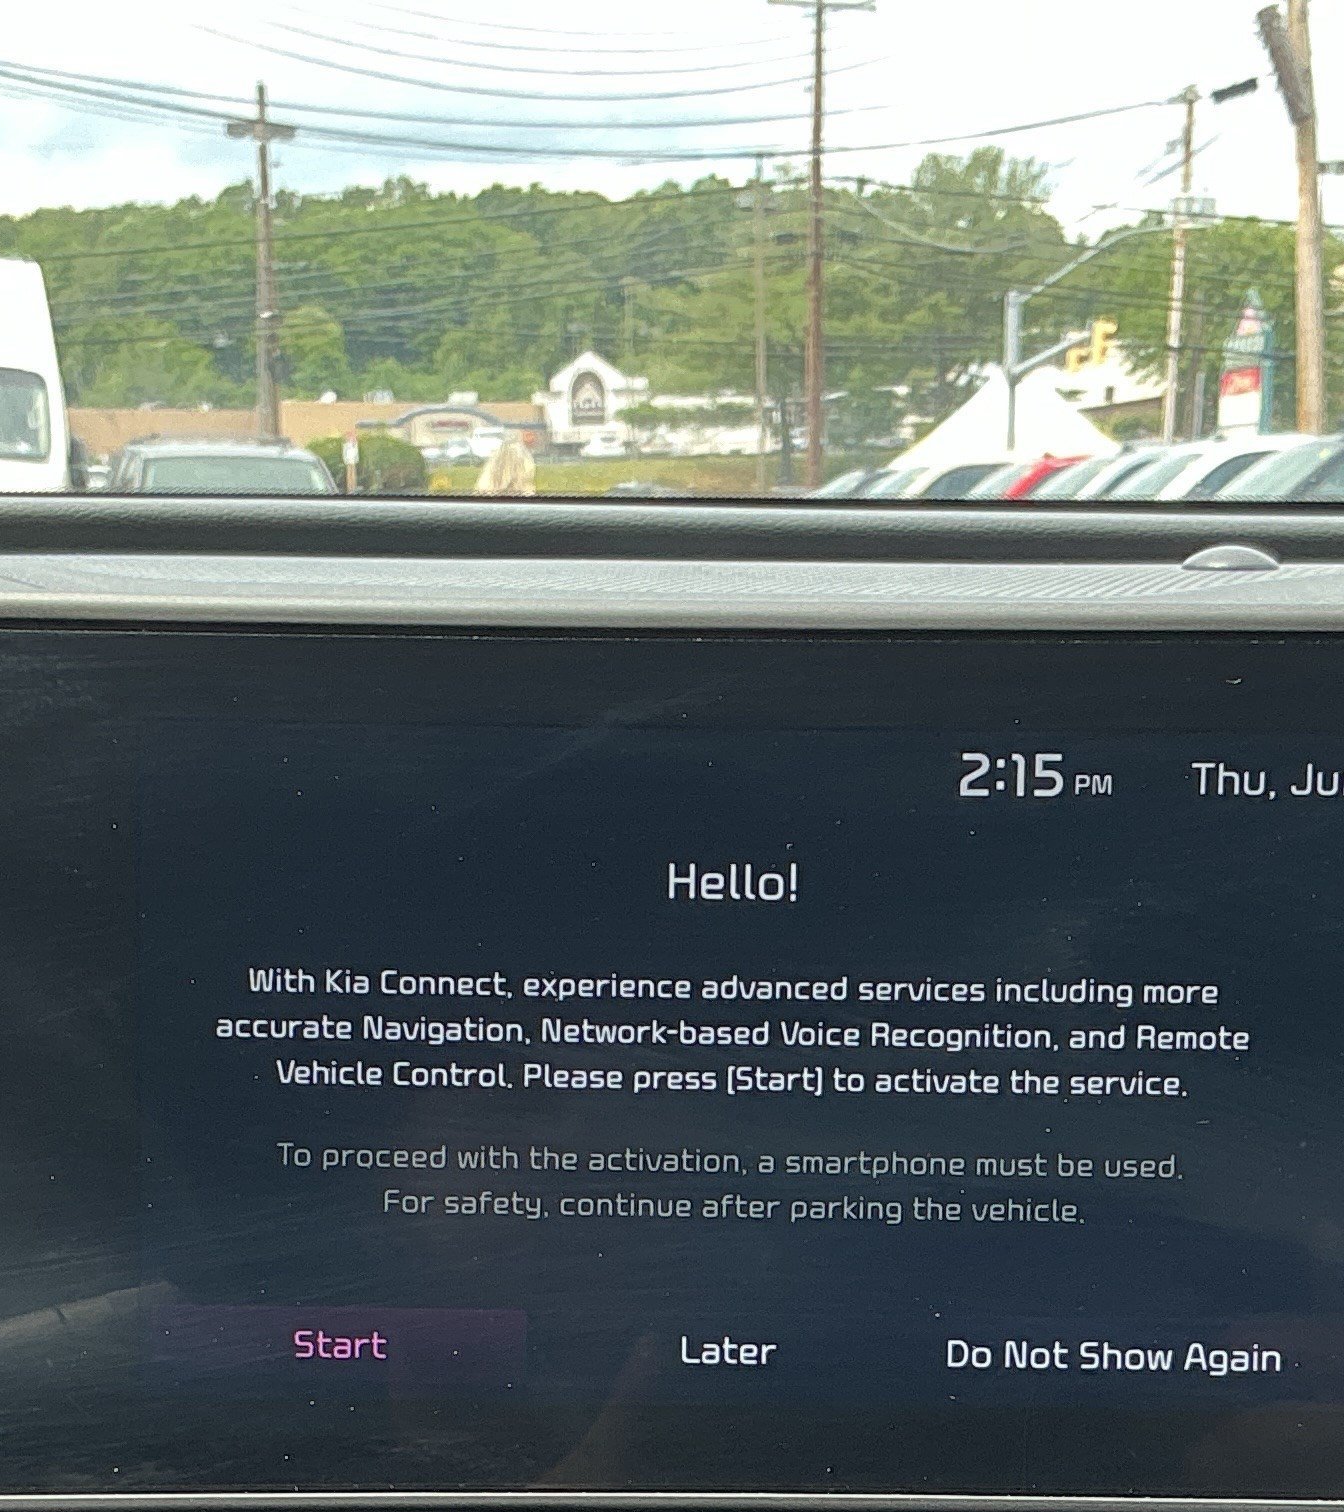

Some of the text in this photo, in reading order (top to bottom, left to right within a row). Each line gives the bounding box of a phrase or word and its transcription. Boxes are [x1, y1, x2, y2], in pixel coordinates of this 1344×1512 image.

[959, 752, 1113, 797] 2:15 PM
[1191, 762, 1276, 800] Thu,
[668, 862, 797, 903] Hello!
[249, 967, 1219, 1008] With Kia Connect, experience advanced services including more
[216, 1014, 1250, 1052] accurate Navigation, Network-based Voice Recognition, and Remote
[275, 1059, 1188, 1097] Vehicle Control. Please press [Start] to activate the service.
[276, 1142, 1183, 1180] To proceed with the activation, a smartphone must be used.
[384, 1189, 1085, 1225] For safety, continue after parking the vehicle.
[294, 1330, 388, 1359] Start
[681, 1335, 777, 1365] Later
[946, 1339, 1281, 1376] Do Not Show Again
